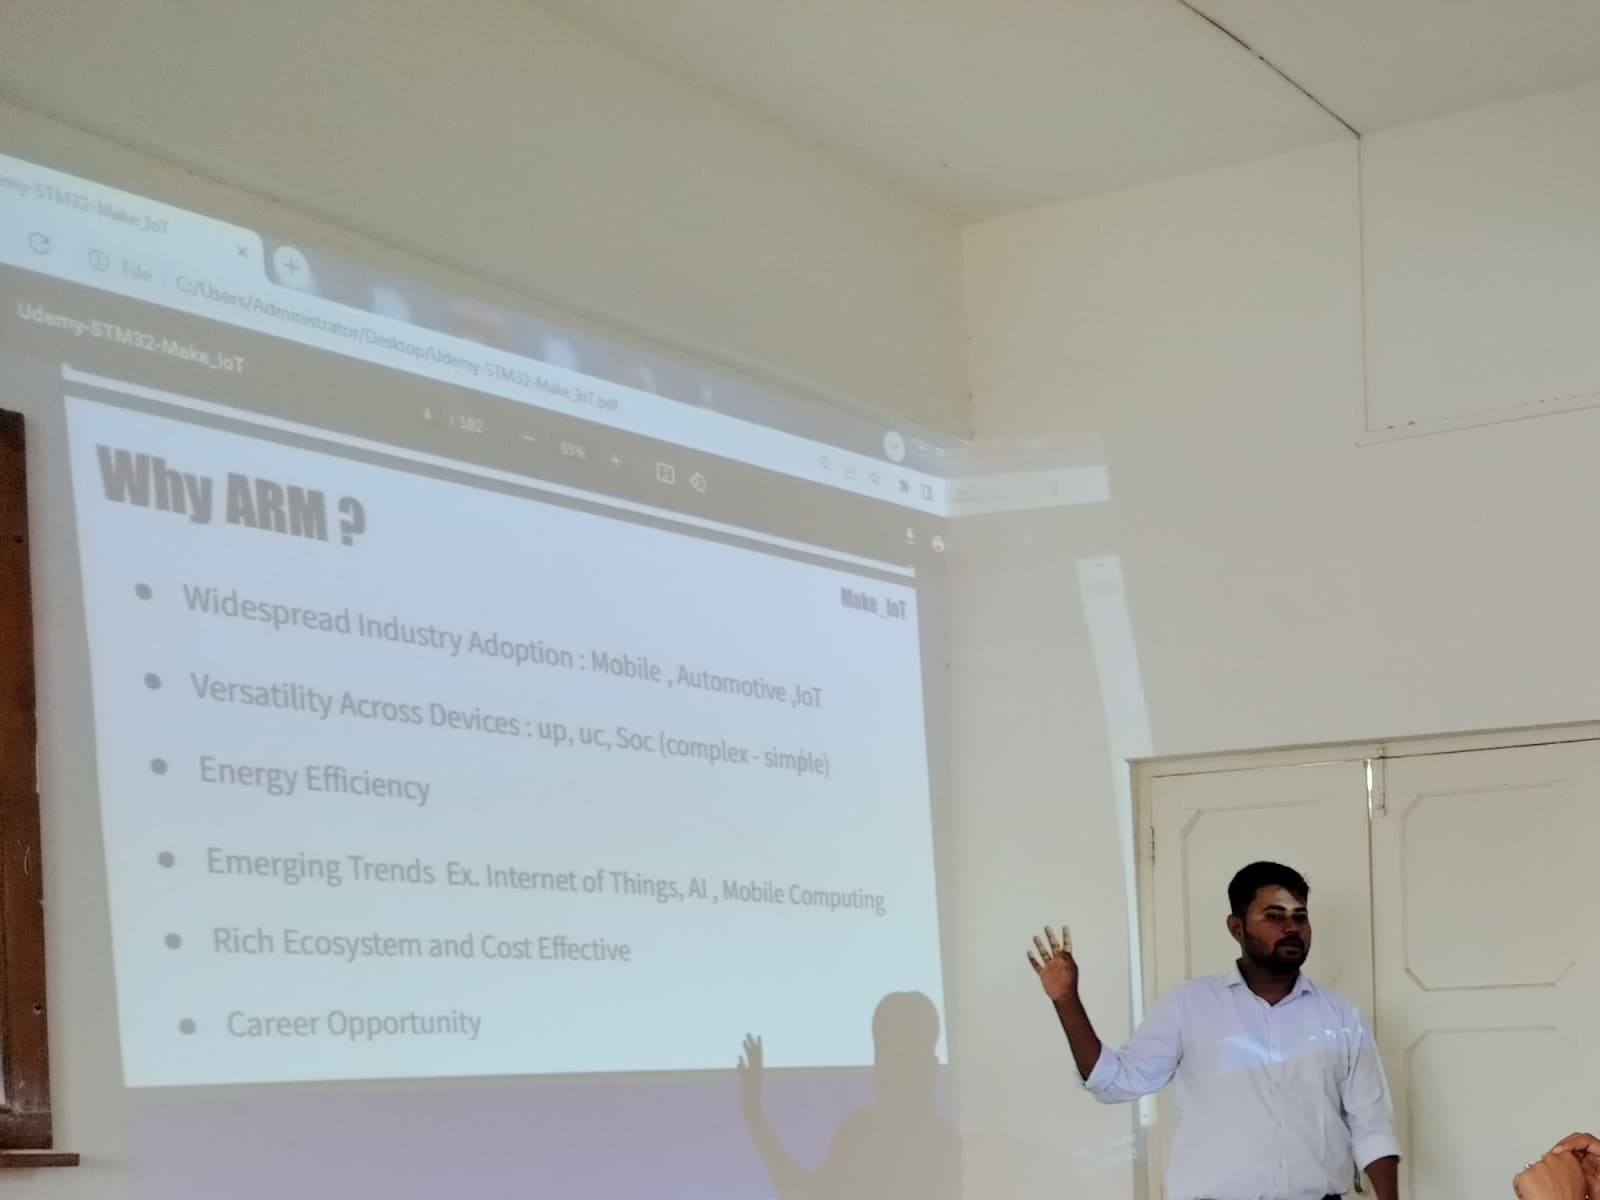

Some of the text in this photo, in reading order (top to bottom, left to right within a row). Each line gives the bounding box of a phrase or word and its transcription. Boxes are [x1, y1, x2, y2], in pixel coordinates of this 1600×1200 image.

[122, 259, 153, 284] File
[17, 302, 246, 374] Udemy-STM32-Make_IoT
[96, 444, 367, 546] Why ARM ?
[840, 587, 907, 622] Make_IoT
[183, 583, 351, 636] Widespread
[358, 612, 463, 657] Industry
[467, 630, 574, 669] Adoption
[591, 650, 662, 683] Mobile
[676, 664, 787, 704] Automotive
[190, 671, 333, 721] Versatility
[338, 691, 424, 726] Across
[429, 703, 521, 738] Devices
[537, 720, 576, 748] up,
[578, 725, 612, 752] uc,
[615, 726, 656, 754] Soc
[659, 731, 750, 767] (complex
[764, 748, 831, 779] simple)
[199, 755, 432, 808] Energy Efficiency
[206, 847, 343, 887] Emerging
[347, 853, 436, 886] Trends
[446, 861, 480, 888] Ex.
[486, 864, 579, 894] Internet
[582, 869, 606, 895] of
[609, 871, 685, 904] Things,
[687, 877, 707, 900] AI
[722, 879, 786, 905] Mobile
[788, 884, 887, 917] Computing
[212, 926, 632, 964] Rich Ecosystem and Cost Effective
[227, 1009, 482, 1043] Career Opportunity
